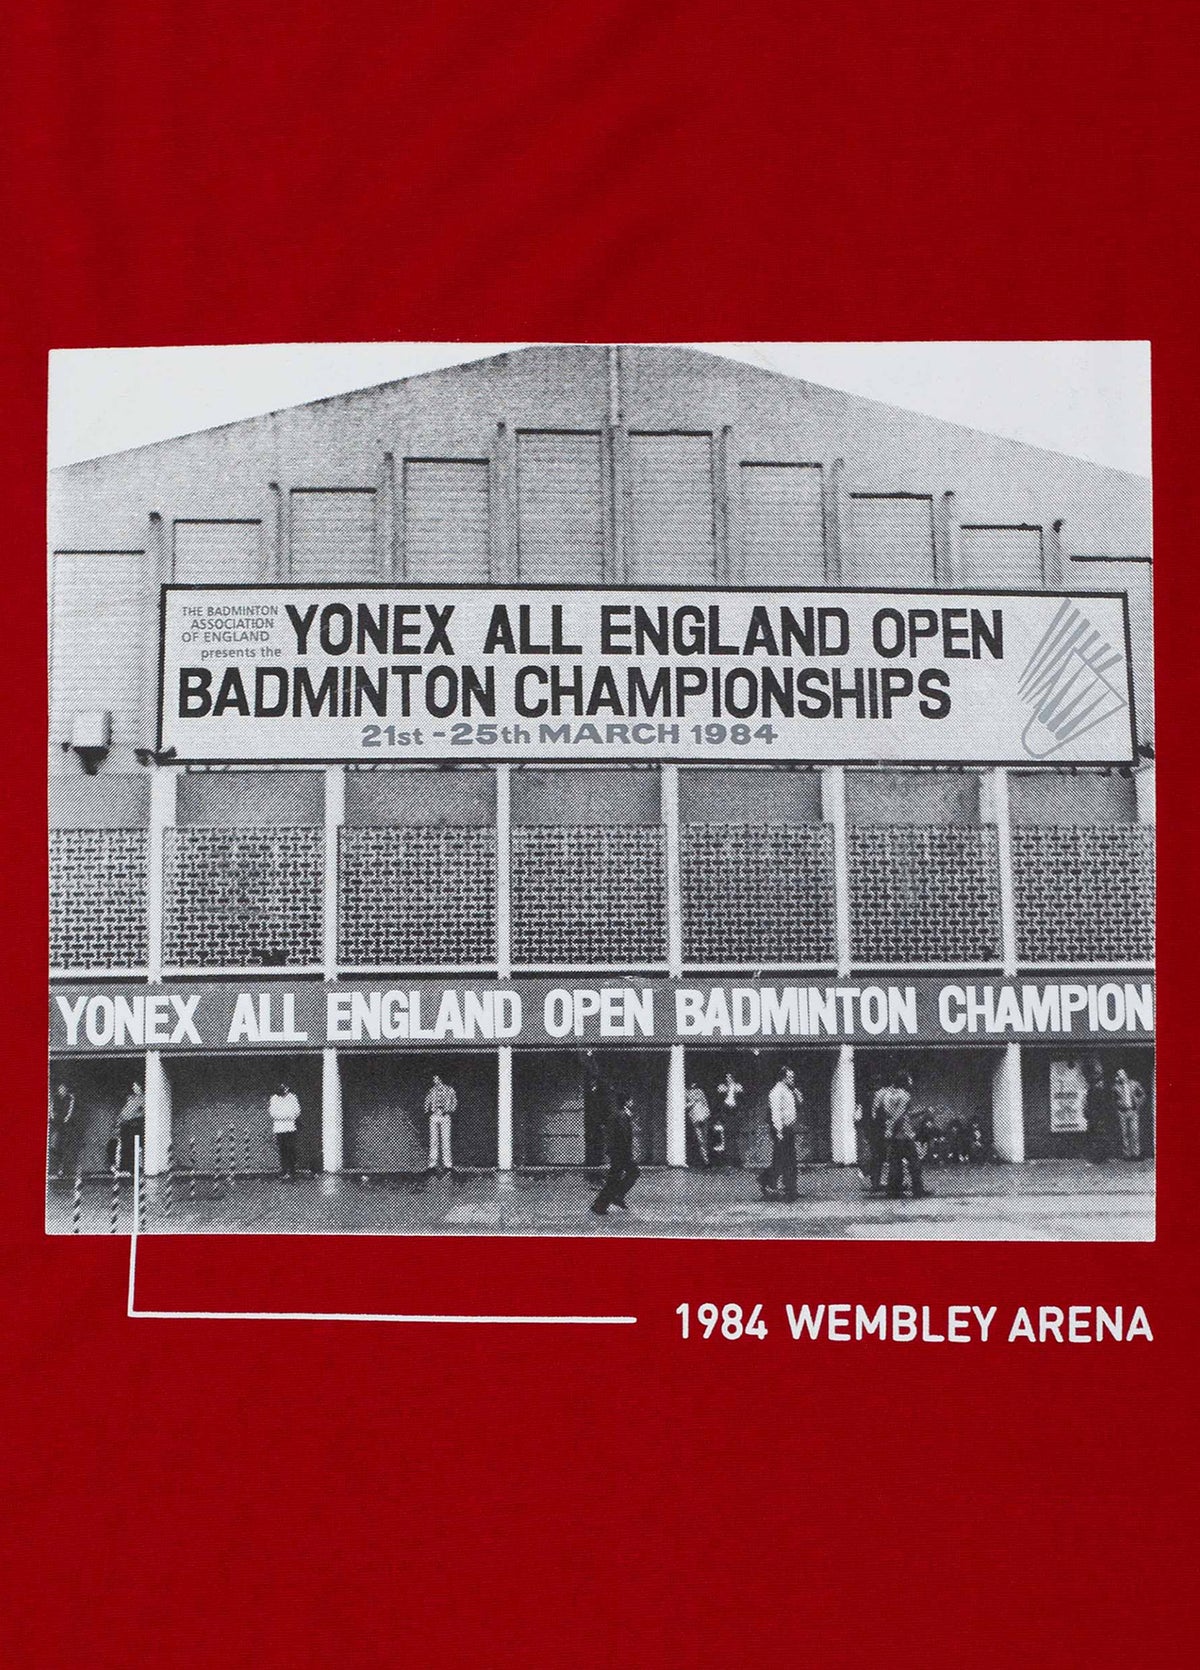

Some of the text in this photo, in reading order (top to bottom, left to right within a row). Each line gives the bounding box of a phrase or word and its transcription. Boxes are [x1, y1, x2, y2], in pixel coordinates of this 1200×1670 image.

[182, 606, 278, 616] THE BADMINTON
[191, 618, 274, 629] ASSOCIATION
[285, 603, 1004, 659] YONEX ALL ENGLAND OPEN
[182, 631, 270, 642] OF ENGLAND
[201, 646, 282, 661] presents the
[178, 665, 951, 719] BADMINTON CHAMPIONSHIPS
[361, 723, 423, 746] 21st
[539, 723, 679, 745] MARCH
[692, 723, 779, 745] 1984
[55, 984, 1154, 1046] YONEX ALL ENGLAND OPEN BADMINTON CHAMPION
[676, 1303, 1154, 1343] 1984 WEMBLEY ARENA
